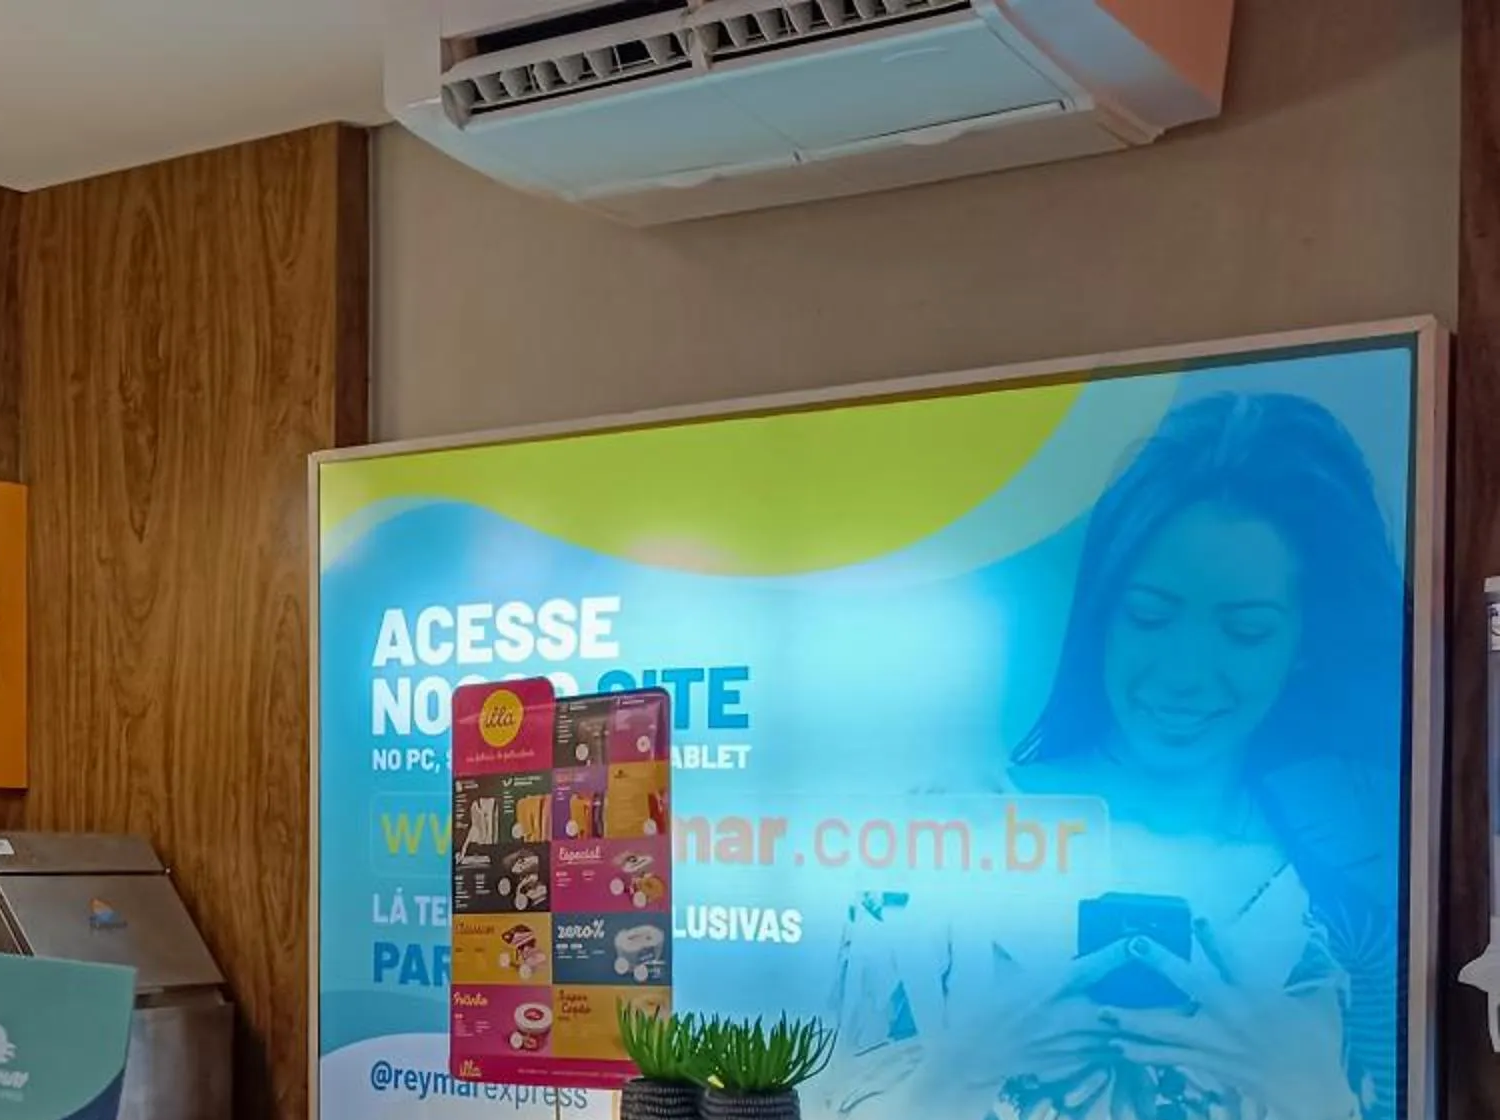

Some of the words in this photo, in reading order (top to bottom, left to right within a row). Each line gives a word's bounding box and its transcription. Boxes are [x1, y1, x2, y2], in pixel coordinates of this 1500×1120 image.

[372, 597, 620, 667] ACESSE
[373, 748, 401, 770] NO
[406, 748, 440, 773] PC,
[671, 744, 752, 769] ABLET
[372, 888, 407, 926] LÁ
[415, 897, 450, 927] TE
[673, 905, 802, 944] LUSIVAS
[372, 942, 450, 988] PAR
